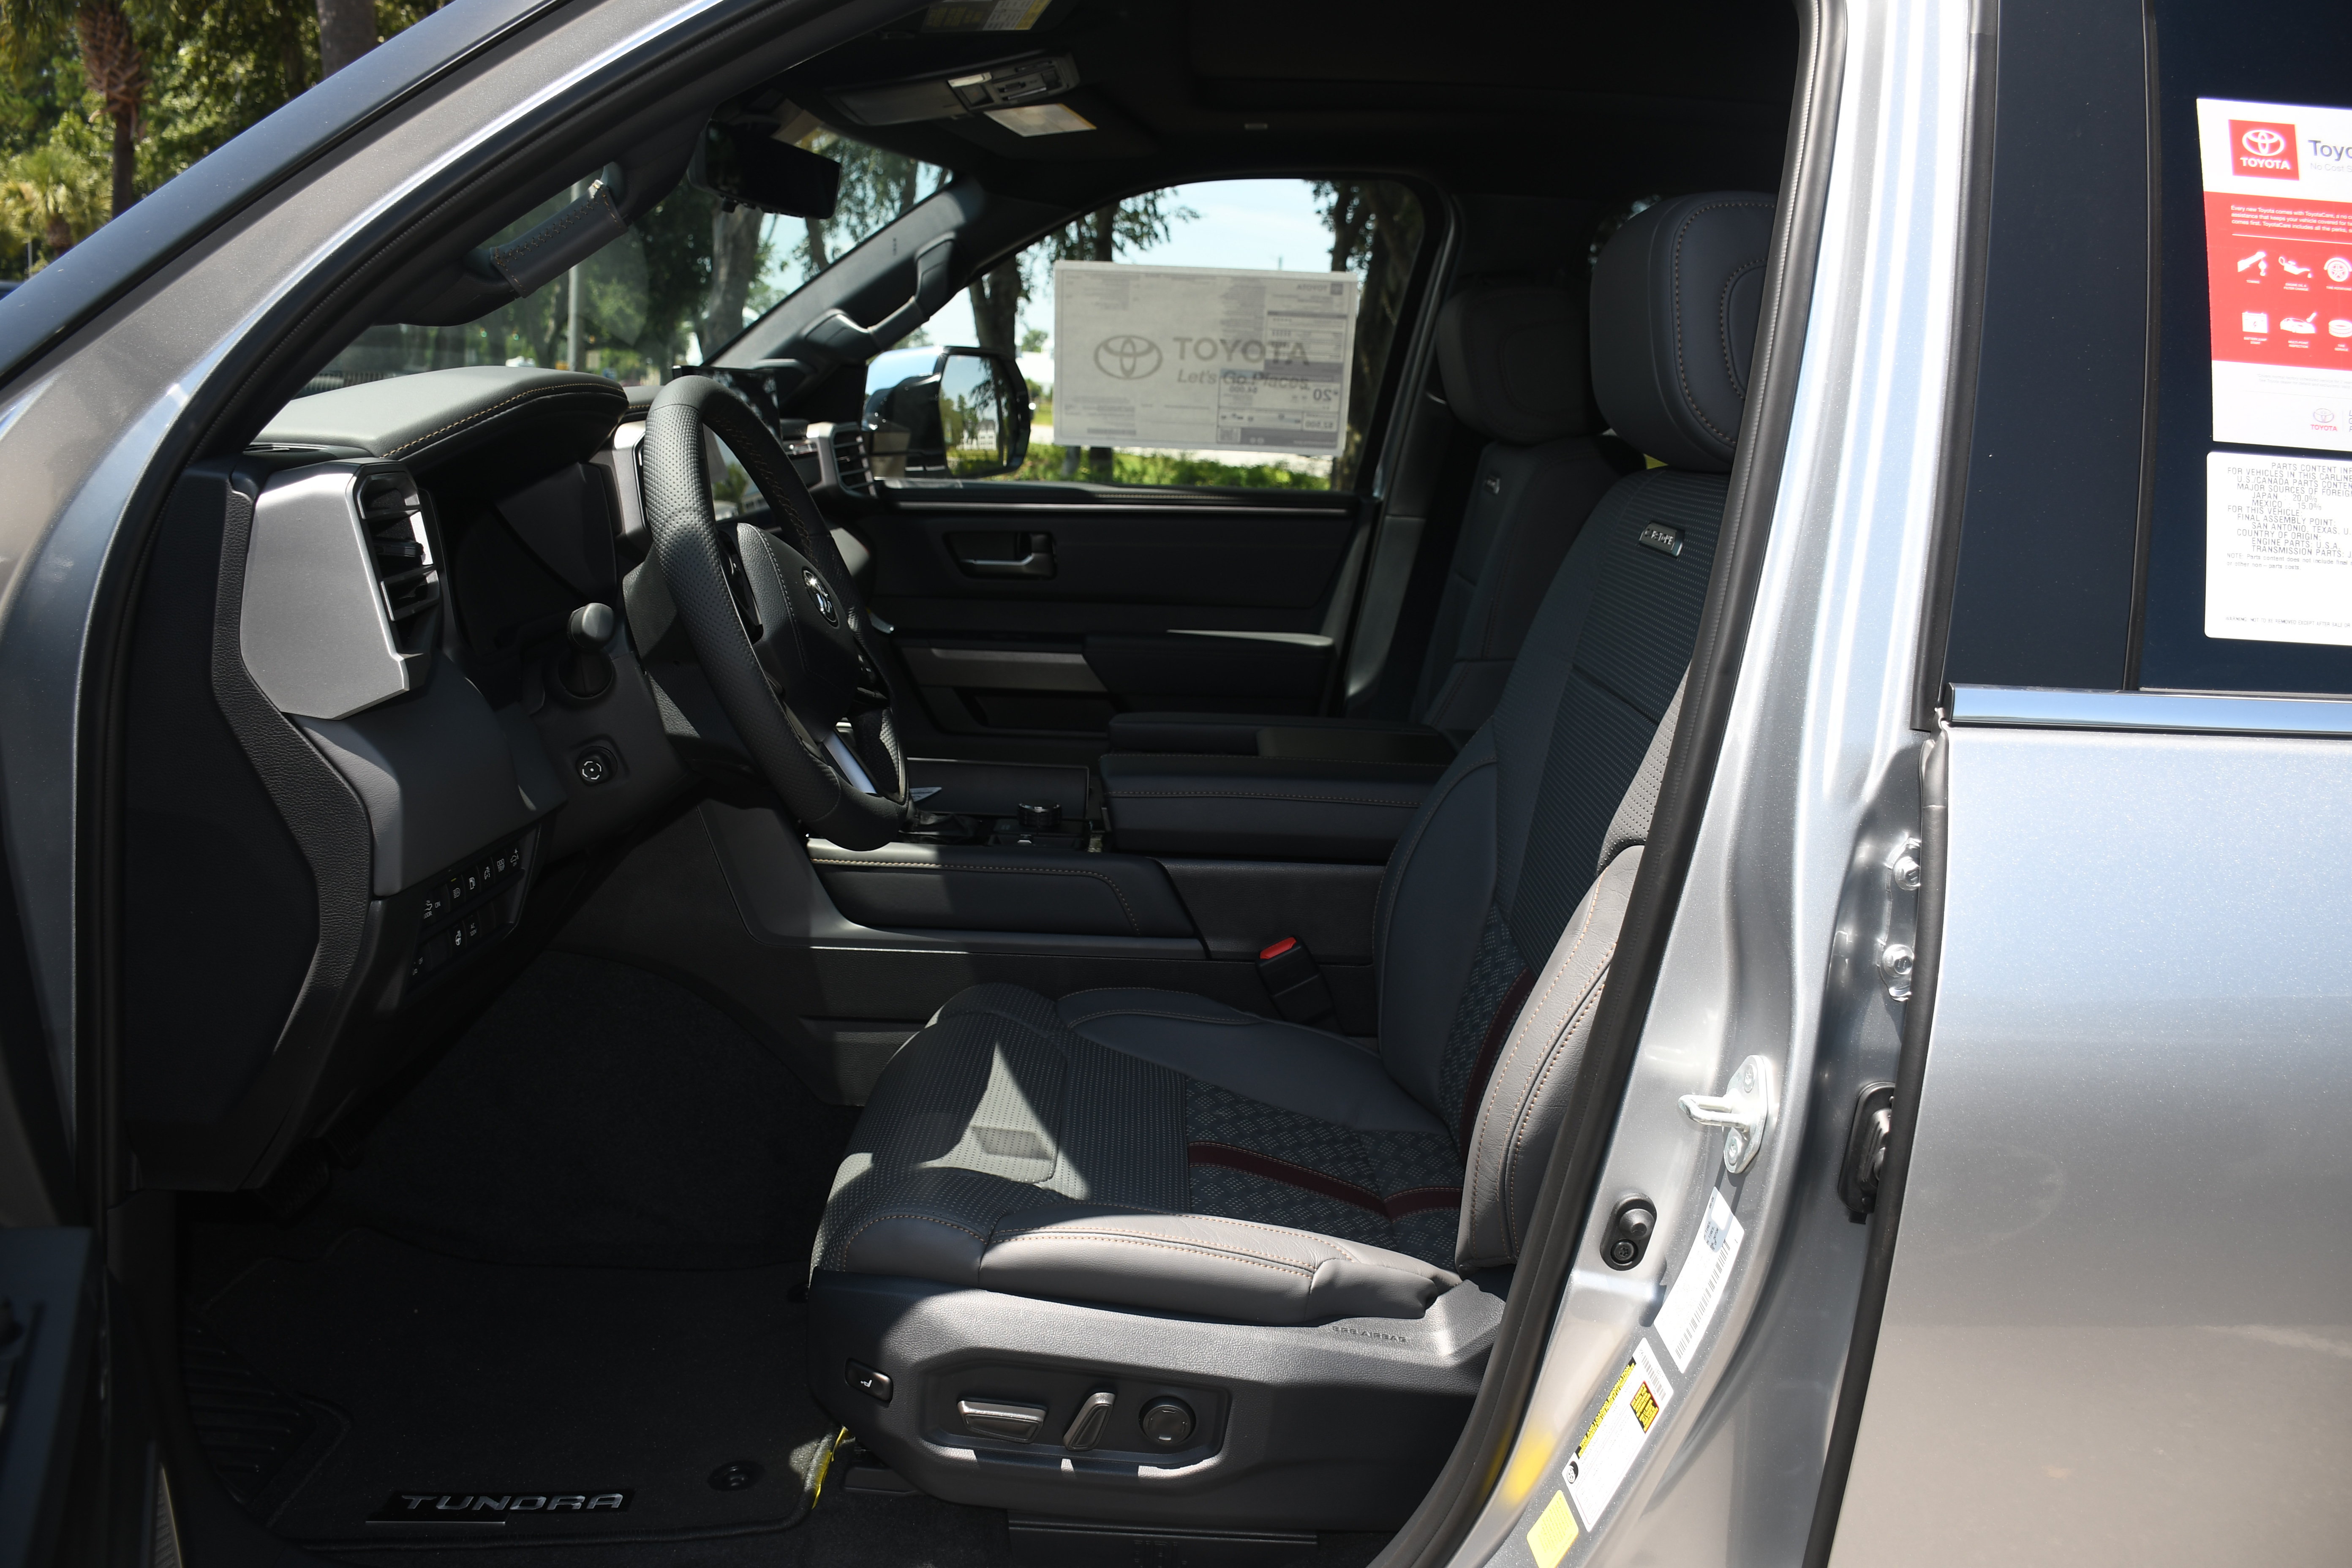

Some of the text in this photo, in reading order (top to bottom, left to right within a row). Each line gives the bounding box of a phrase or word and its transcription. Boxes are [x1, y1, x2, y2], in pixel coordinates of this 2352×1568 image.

[2240, 157, 2290, 170] TOYOTA
[2325, 163, 2344, 172] Cost
[1173, 337, 1309, 366] TOYOTA
[1177, 368, 1217, 384] Let's
[2246, 468, 2284, 477] VEHICLES
[2272, 463, 2297, 471] PARTS
[2300, 464, 2336, 473] CONTENT
[2237, 475, 2289, 485] U.S./CANADA
[2293, 479, 2318, 487] PARTS
[2237, 483, 2265, 491] MAJOR
[2268, 485, 2305, 494] SOURCES
[2322, 488, 2352, 497] FOREIG
[2252, 492, 2317, 503] JAPAN 20.0%
[2252, 499, 2322, 510] MEXICO 15.0%
[2246, 506, 2264, 514] THIS
[2268, 507, 2302, 516] VEHICLE:
[2263, 515, 2306, 524] ASSEMBLY
[2310, 518, 2335, 526] POINT:
[2237, 529, 2274, 537] COUNTRY
[2292, 532, 2321, 541] ORIGIN:
[2252, 537, 2340, 550] ENGINE PARTS: U.S.A.
[2252, 545, 2312, 555] TRANSMISSION
[2316, 549, 2344, 558] PARTS:
[1361, 1331, 1406, 1342] AIRBAG
[1579, 1434, 1587, 1449] TIRE
[1586, 1422, 1594, 1437] AND
[1593, 1399, 1608, 1425] LOADING
[1607, 1363, 1630, 1402] INFORMATION
[402, 1493, 623, 1511] TUNDRA
